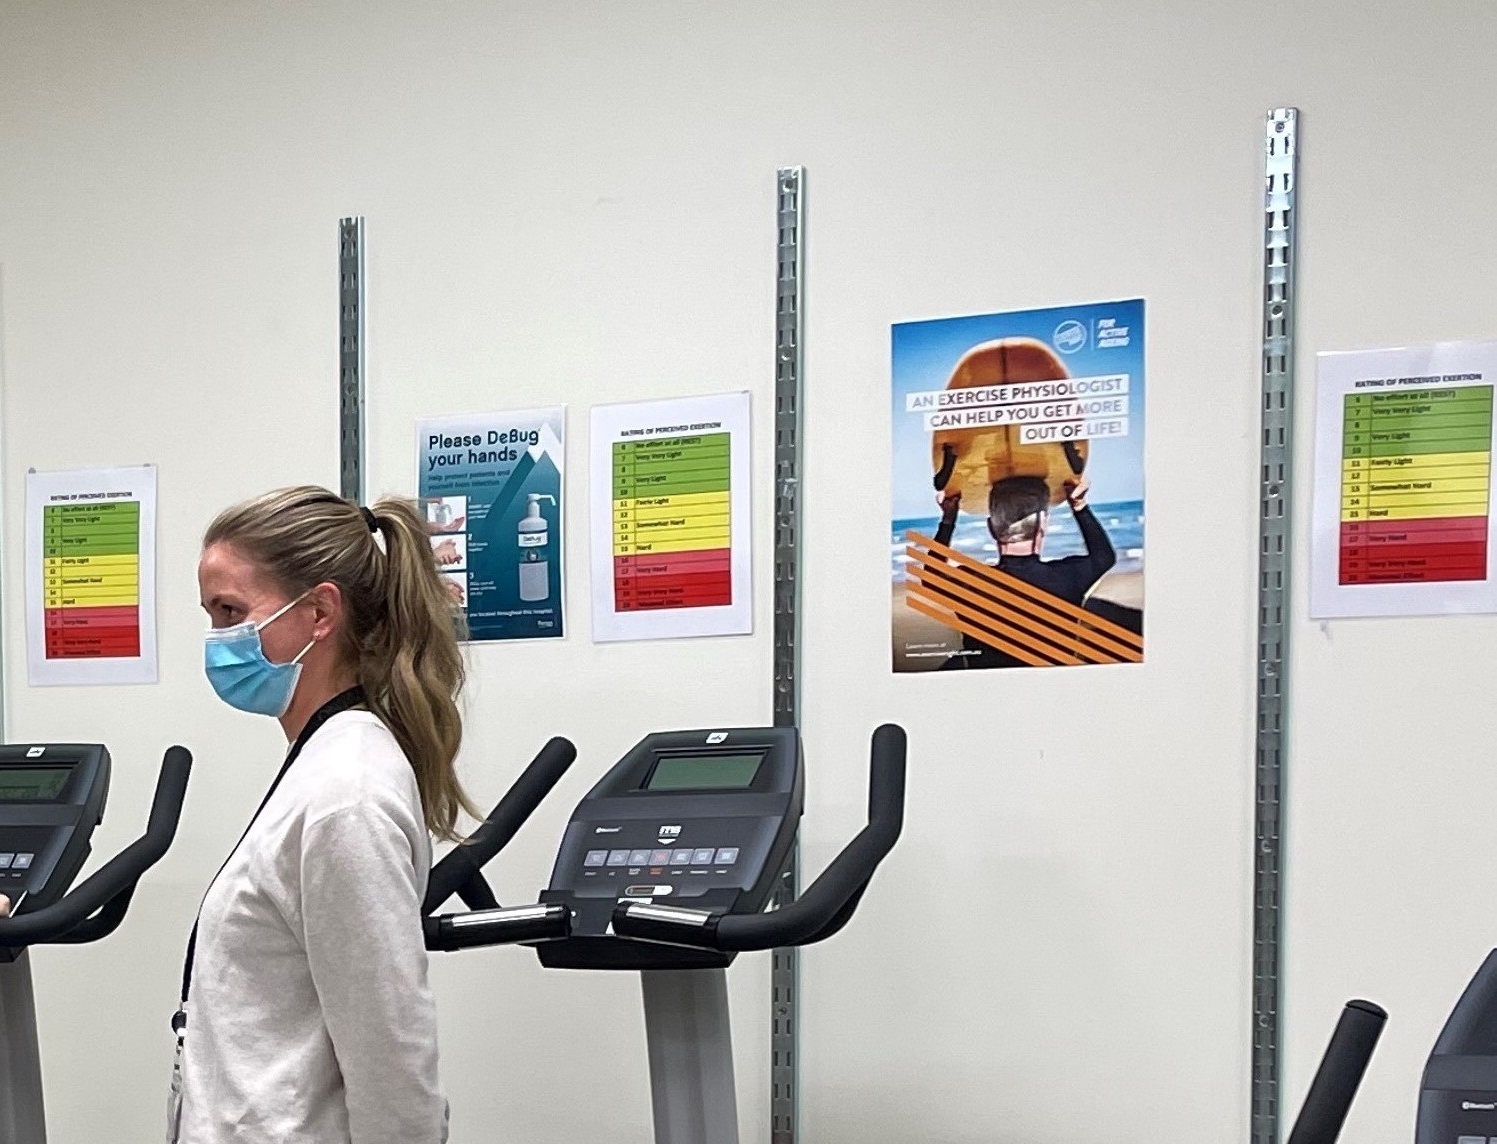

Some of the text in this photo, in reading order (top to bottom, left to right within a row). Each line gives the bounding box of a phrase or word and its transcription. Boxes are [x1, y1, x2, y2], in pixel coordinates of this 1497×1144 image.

[1355, 373, 1482, 388] RATING OF PERCEIVED EXERTION
[912, 377, 1123, 409] AN EXERCISE PHYSIOLOGIST
[930, 400, 1122, 429] CAN HELP YOU GET MORE
[1373, 407, 1390, 415] Very
[1412, 405, 1431, 414] Light
[621, 421, 721, 436] RATING OF PERCEIVED EXERTION
[1025, 421, 1122, 441] OUT OF LIFE!
[429, 428, 539, 450] Please DeBug
[1372, 433, 1390, 441] Very
[1391, 432, 1410, 441] Light
[429, 449, 518, 471] your hands
[667, 451, 682, 459] Light
[1371, 458, 1392, 467] Fairly
[1394, 457, 1413, 466] Light
[651, 475, 666, 483] Light
[1413, 482, 1432, 490] Hard
[1369, 509, 1388, 517] Hard
[670, 518, 685, 526] Hard
